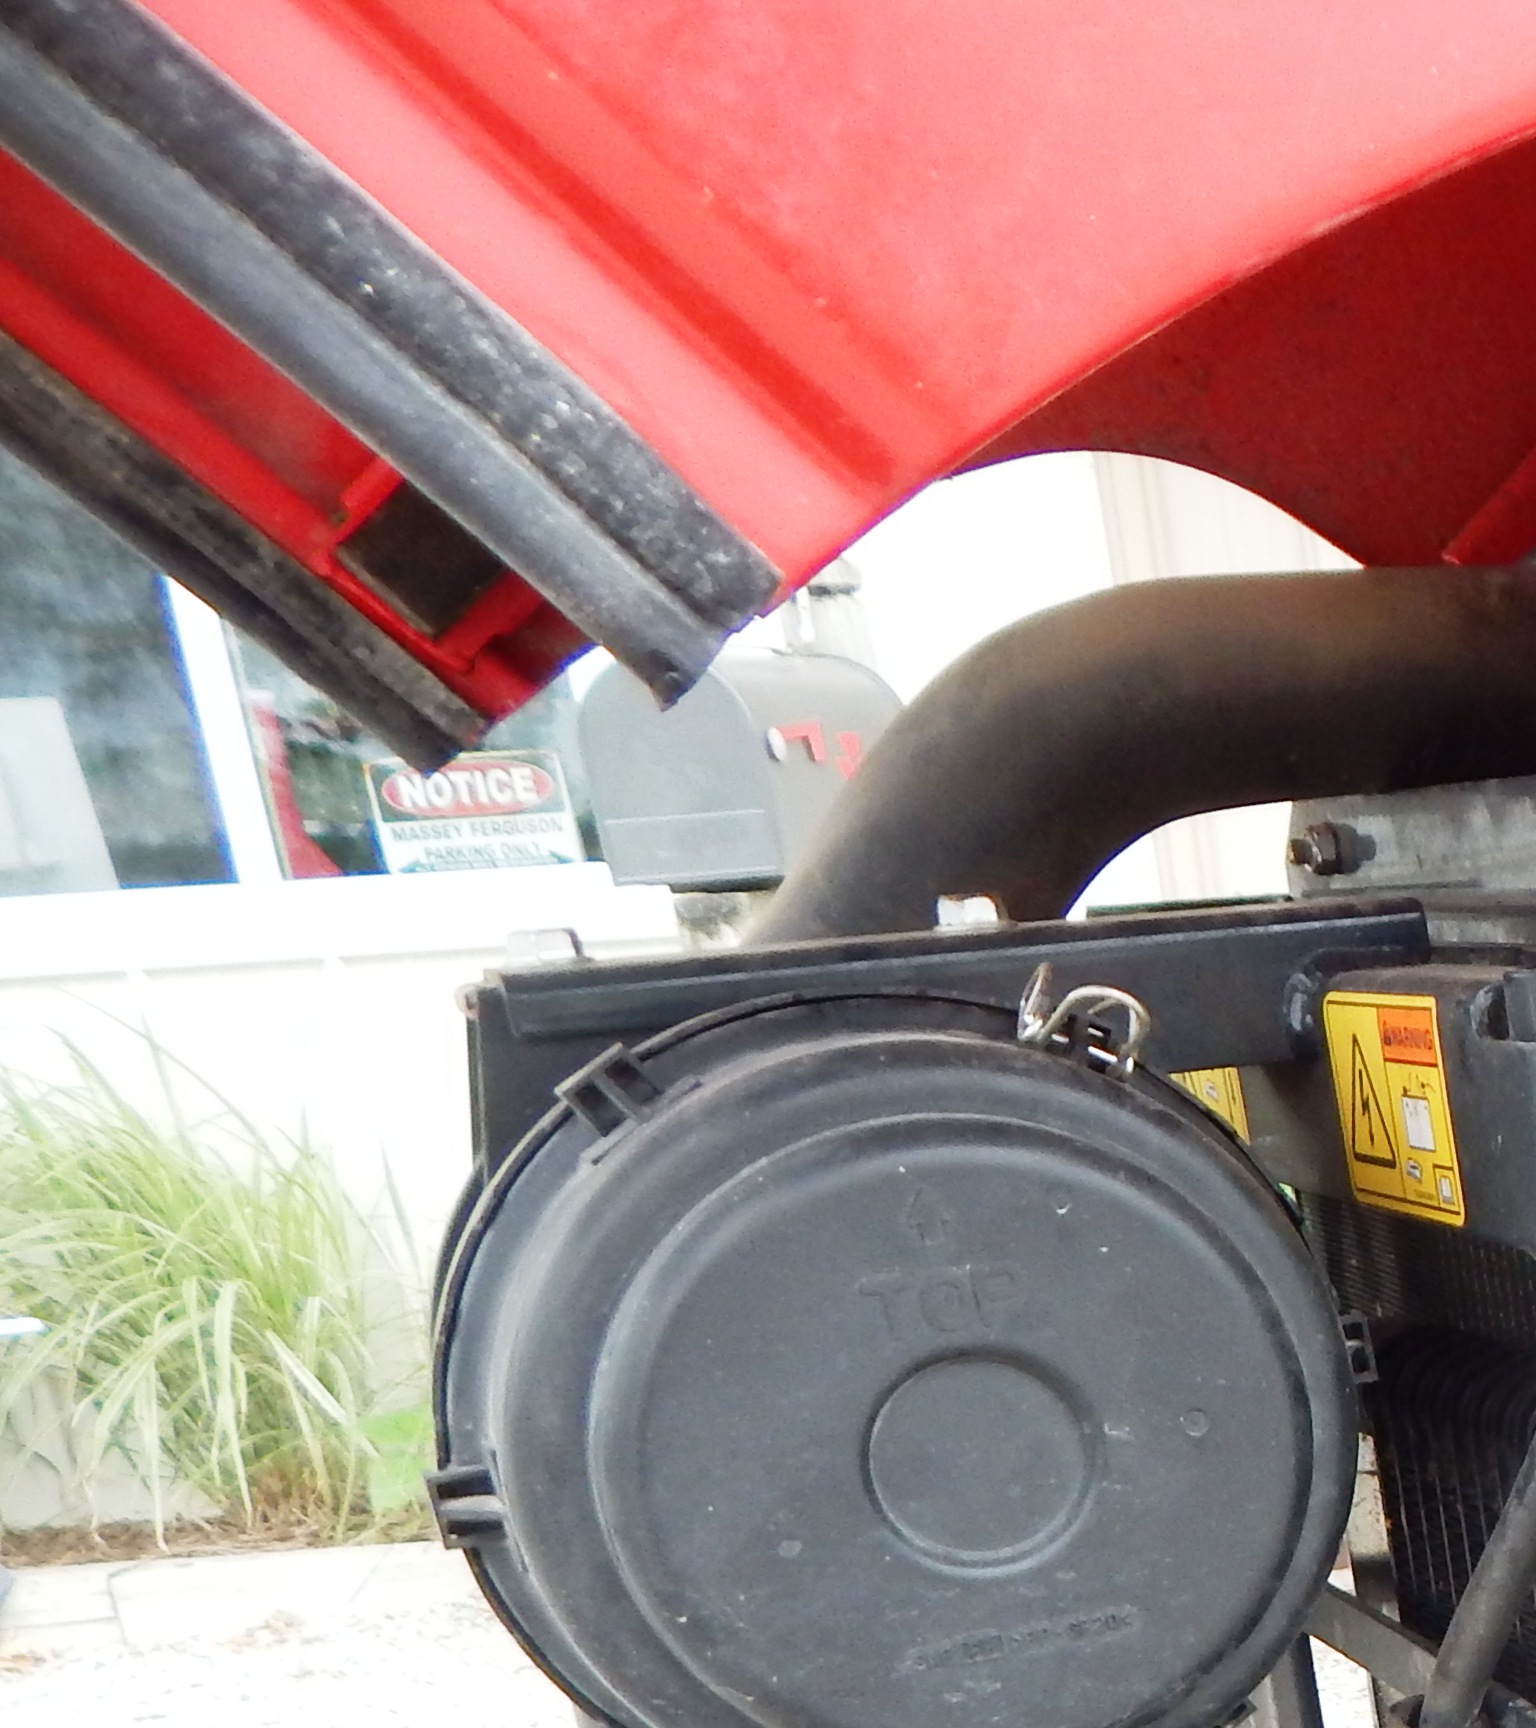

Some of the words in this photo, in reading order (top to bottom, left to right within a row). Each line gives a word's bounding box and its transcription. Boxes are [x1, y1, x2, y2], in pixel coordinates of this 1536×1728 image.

[396, 766, 541, 809] NOTICE
[391, 823, 462, 842] MASSEY
[471, 816, 563, 838] FERGUSON
[425, 842, 495, 861] PARKING
[501, 841, 544, 859] ONLY
[855, 1260, 1029, 1341] TOP
